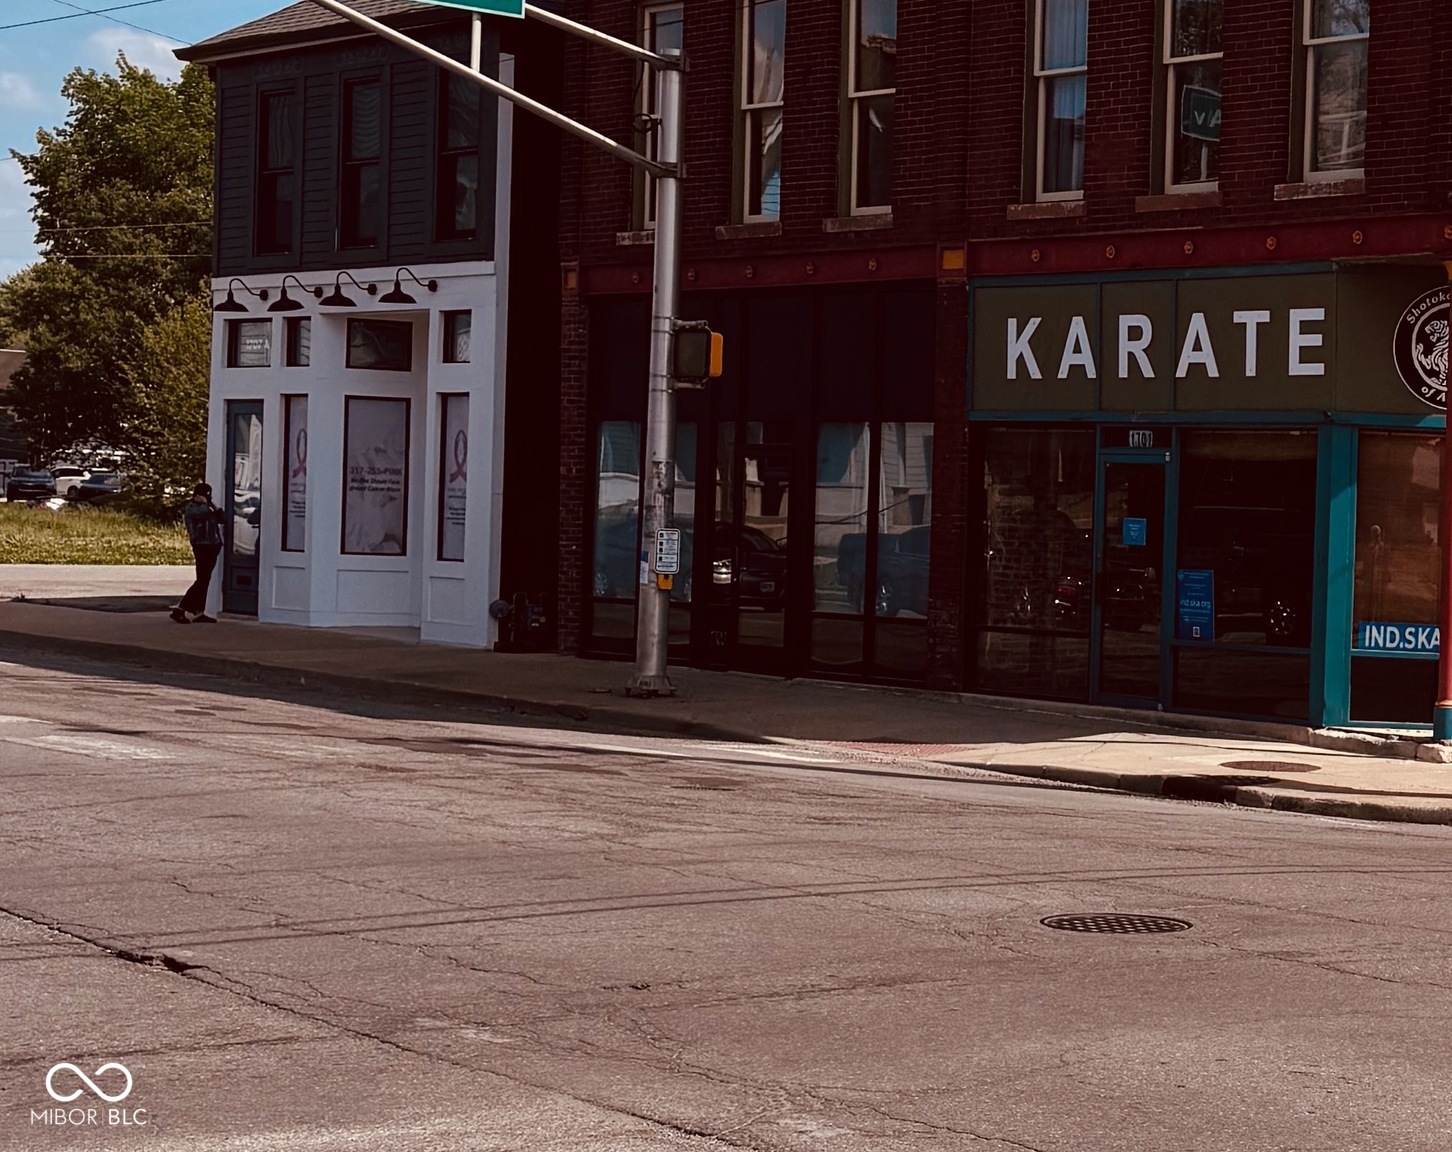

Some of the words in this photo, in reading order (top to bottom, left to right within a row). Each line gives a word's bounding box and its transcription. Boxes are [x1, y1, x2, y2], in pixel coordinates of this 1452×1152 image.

[1406, 291, 1451, 324] Shotoka
[1005, 307, 1326, 380] KARATE
[1421, 386, 1437, 398] of
[1130, 431, 1152, 448] 1701
